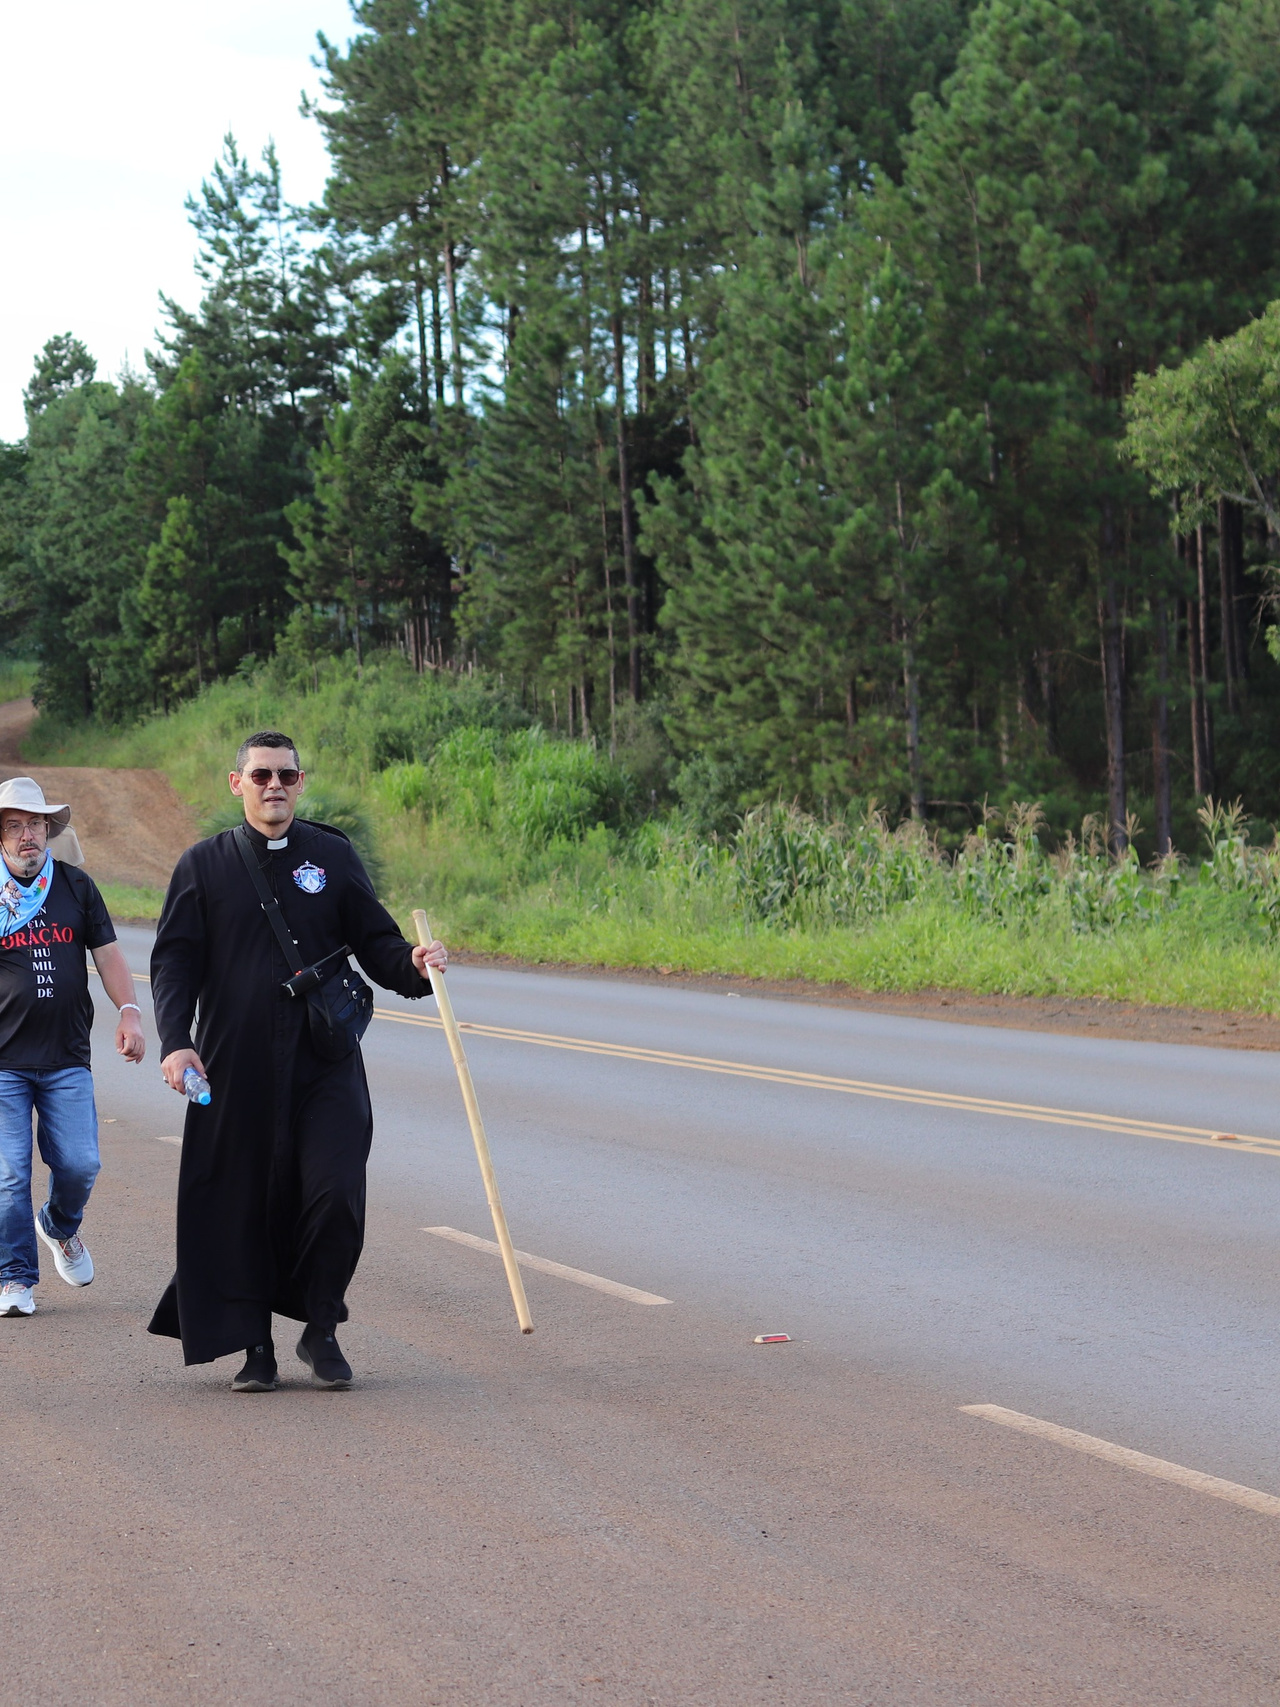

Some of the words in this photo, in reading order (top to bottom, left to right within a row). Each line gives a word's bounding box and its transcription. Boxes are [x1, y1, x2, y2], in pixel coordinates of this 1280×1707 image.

[1, 923, 73, 950] ORAÇÃO
[33, 947, 51, 958] HU
[32, 961, 56, 971] MIL
[36, 974, 54, 985] DA
[37, 988, 54, 998] DE
